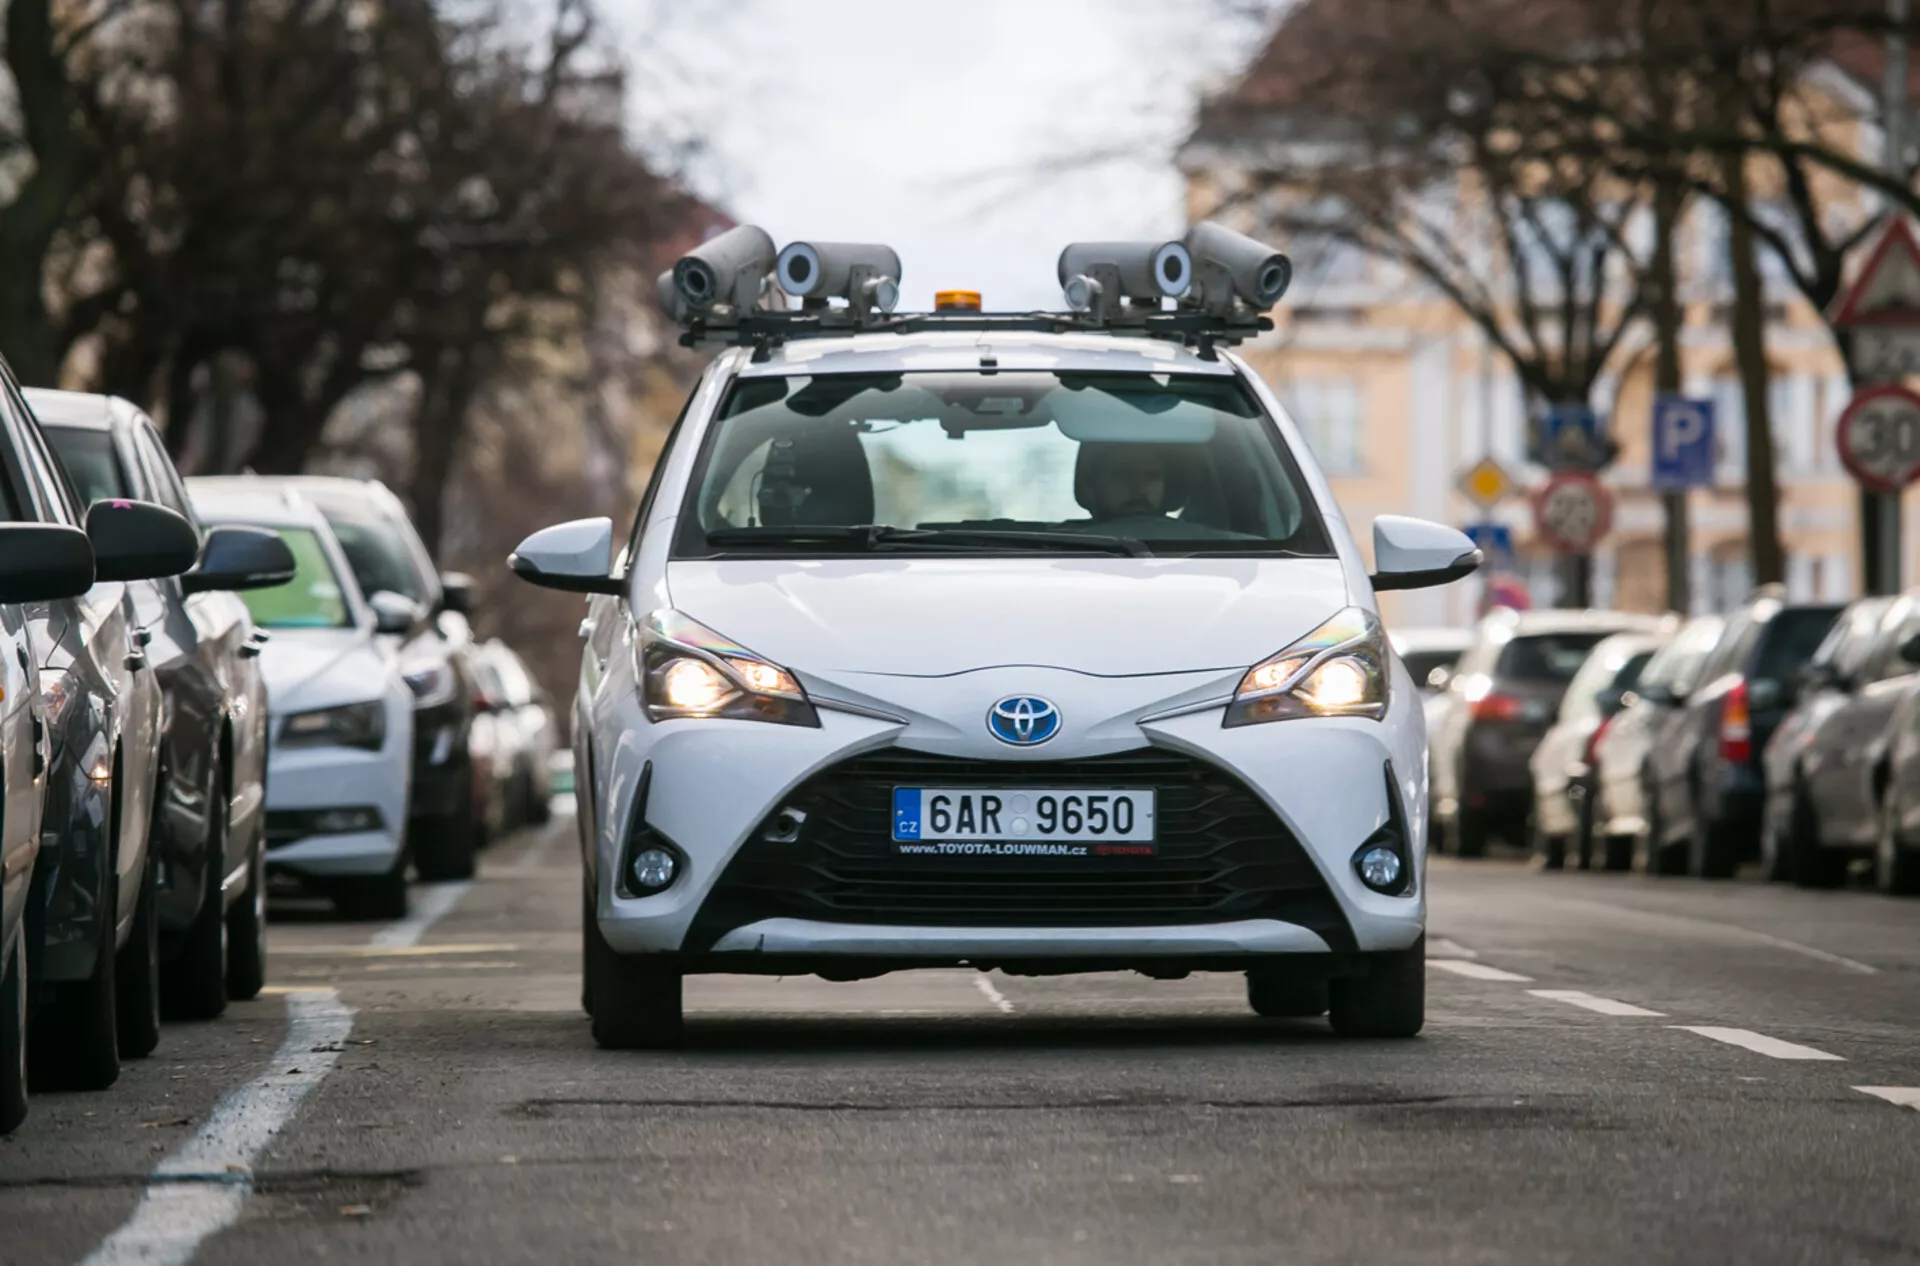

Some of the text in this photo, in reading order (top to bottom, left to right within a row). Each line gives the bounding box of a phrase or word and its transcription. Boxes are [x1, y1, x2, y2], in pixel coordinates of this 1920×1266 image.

[1663, 404, 1705, 458] P
[1856, 410, 1920, 464] 30
[899, 821, 917, 833] CZ
[929, 795, 1134, 835] 6AR 9650
[899, 843, 1087, 856] www.TOYOTA-LOUWMAN.cz
